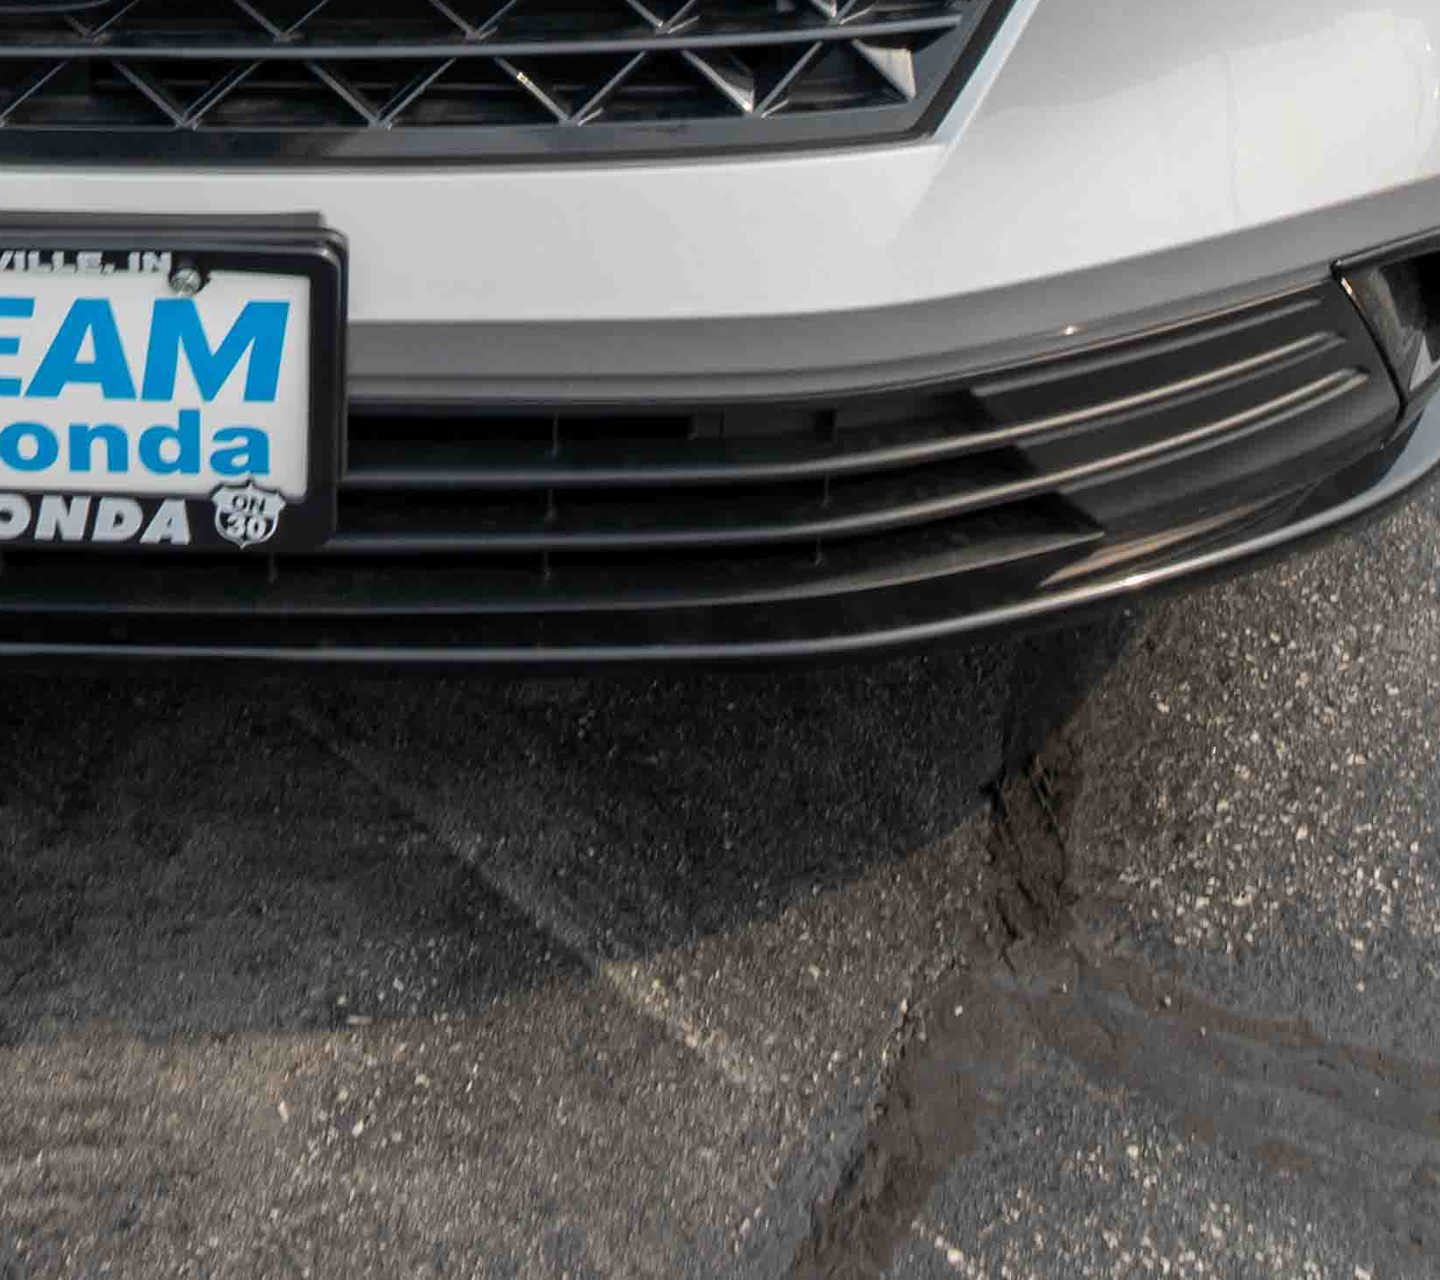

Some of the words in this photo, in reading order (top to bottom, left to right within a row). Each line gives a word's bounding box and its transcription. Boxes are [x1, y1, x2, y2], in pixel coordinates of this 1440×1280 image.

[128, 251, 172, 274] IN
[231, 495, 267, 511] ON
[225, 514, 268, 537] 30
